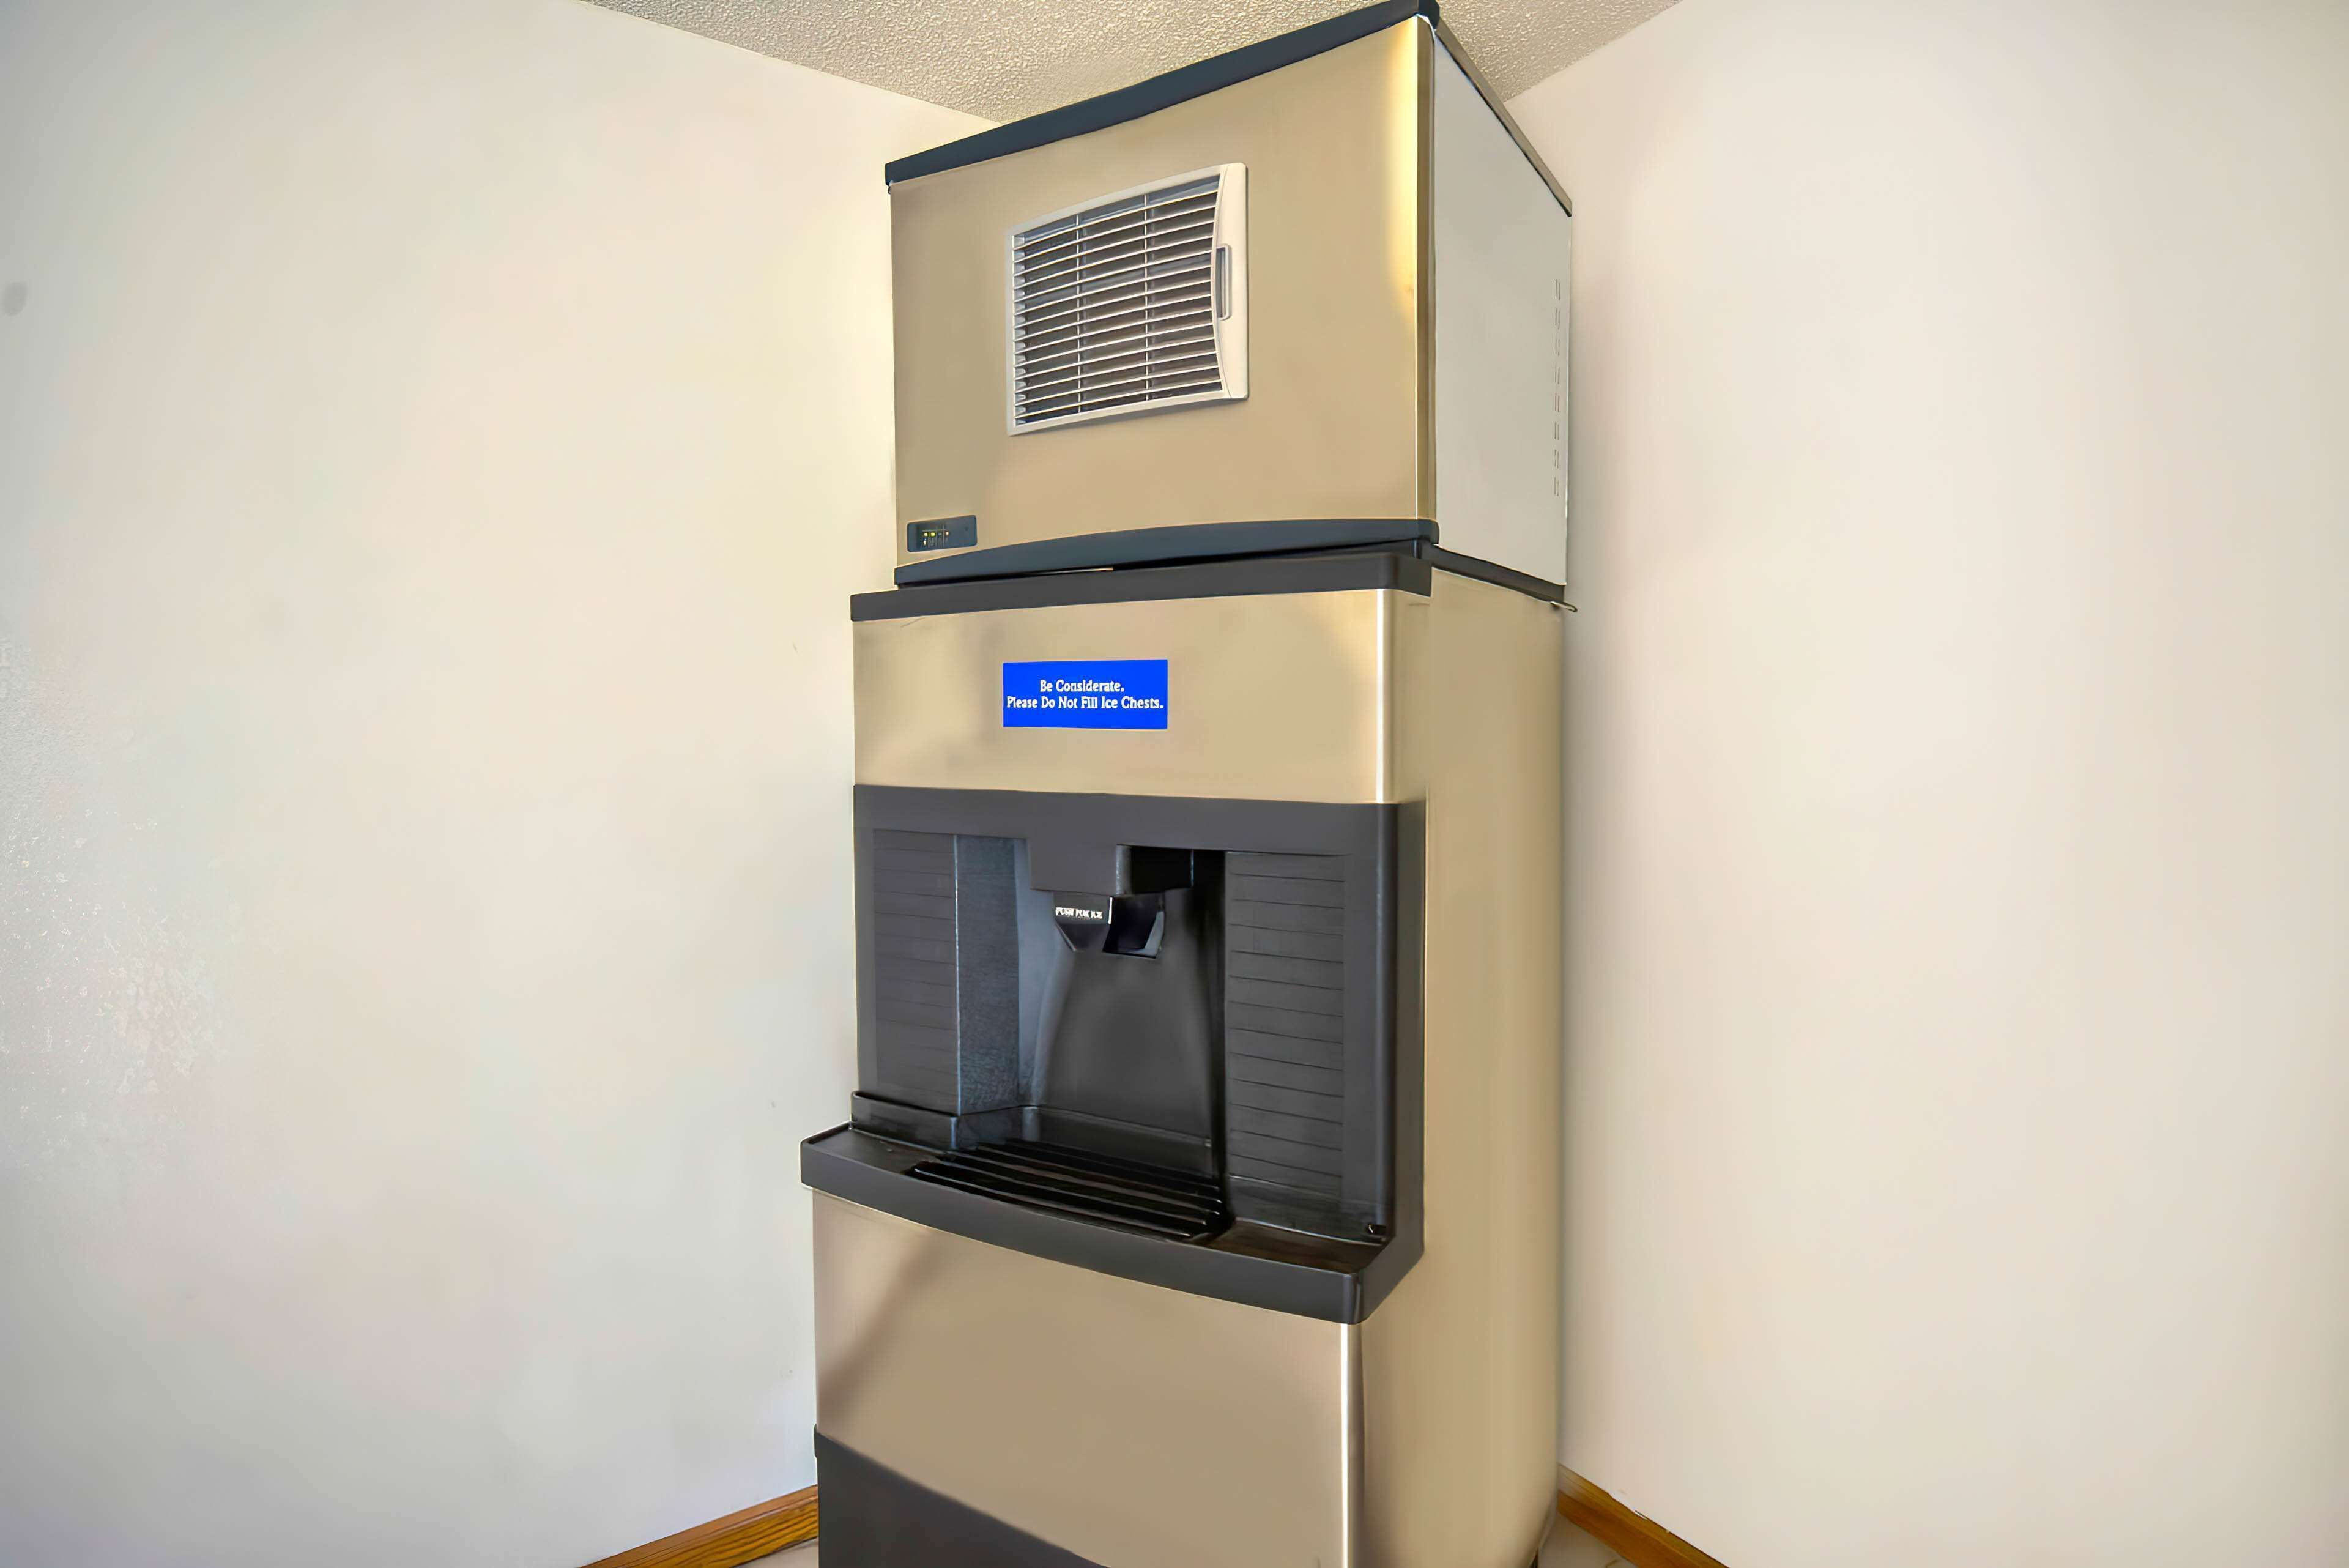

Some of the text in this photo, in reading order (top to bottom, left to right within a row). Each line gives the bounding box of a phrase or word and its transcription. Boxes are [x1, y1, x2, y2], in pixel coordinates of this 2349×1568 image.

[1040, 679, 1124, 693] Be Considerate.
[1006, 696, 1164, 709] Please Do Not Fill Ice Chests.
